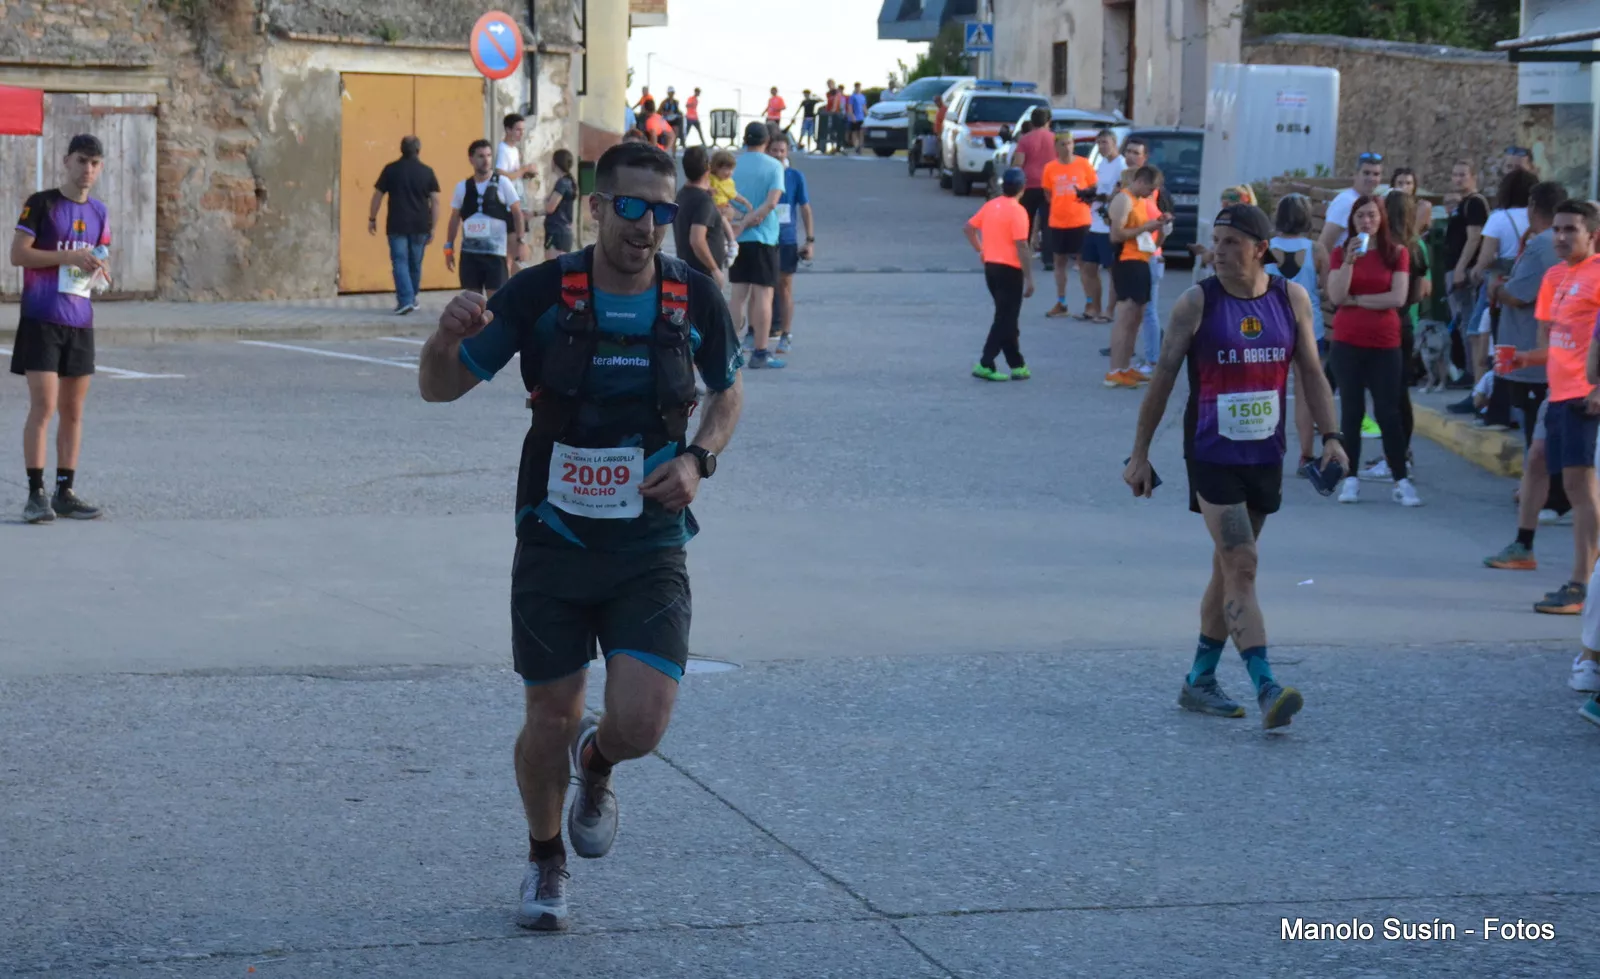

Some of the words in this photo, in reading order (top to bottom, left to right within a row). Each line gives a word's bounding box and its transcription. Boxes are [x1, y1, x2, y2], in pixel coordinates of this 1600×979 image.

[1217, 348, 1241, 364] C.A.
[1243, 347, 1286, 363] ABRERA
[1228, 401, 1273, 418] 1506
[1239, 417, 1265, 425] DAVID
[561, 462, 630, 486] 2009
[573, 485, 616, 496] NACHO
